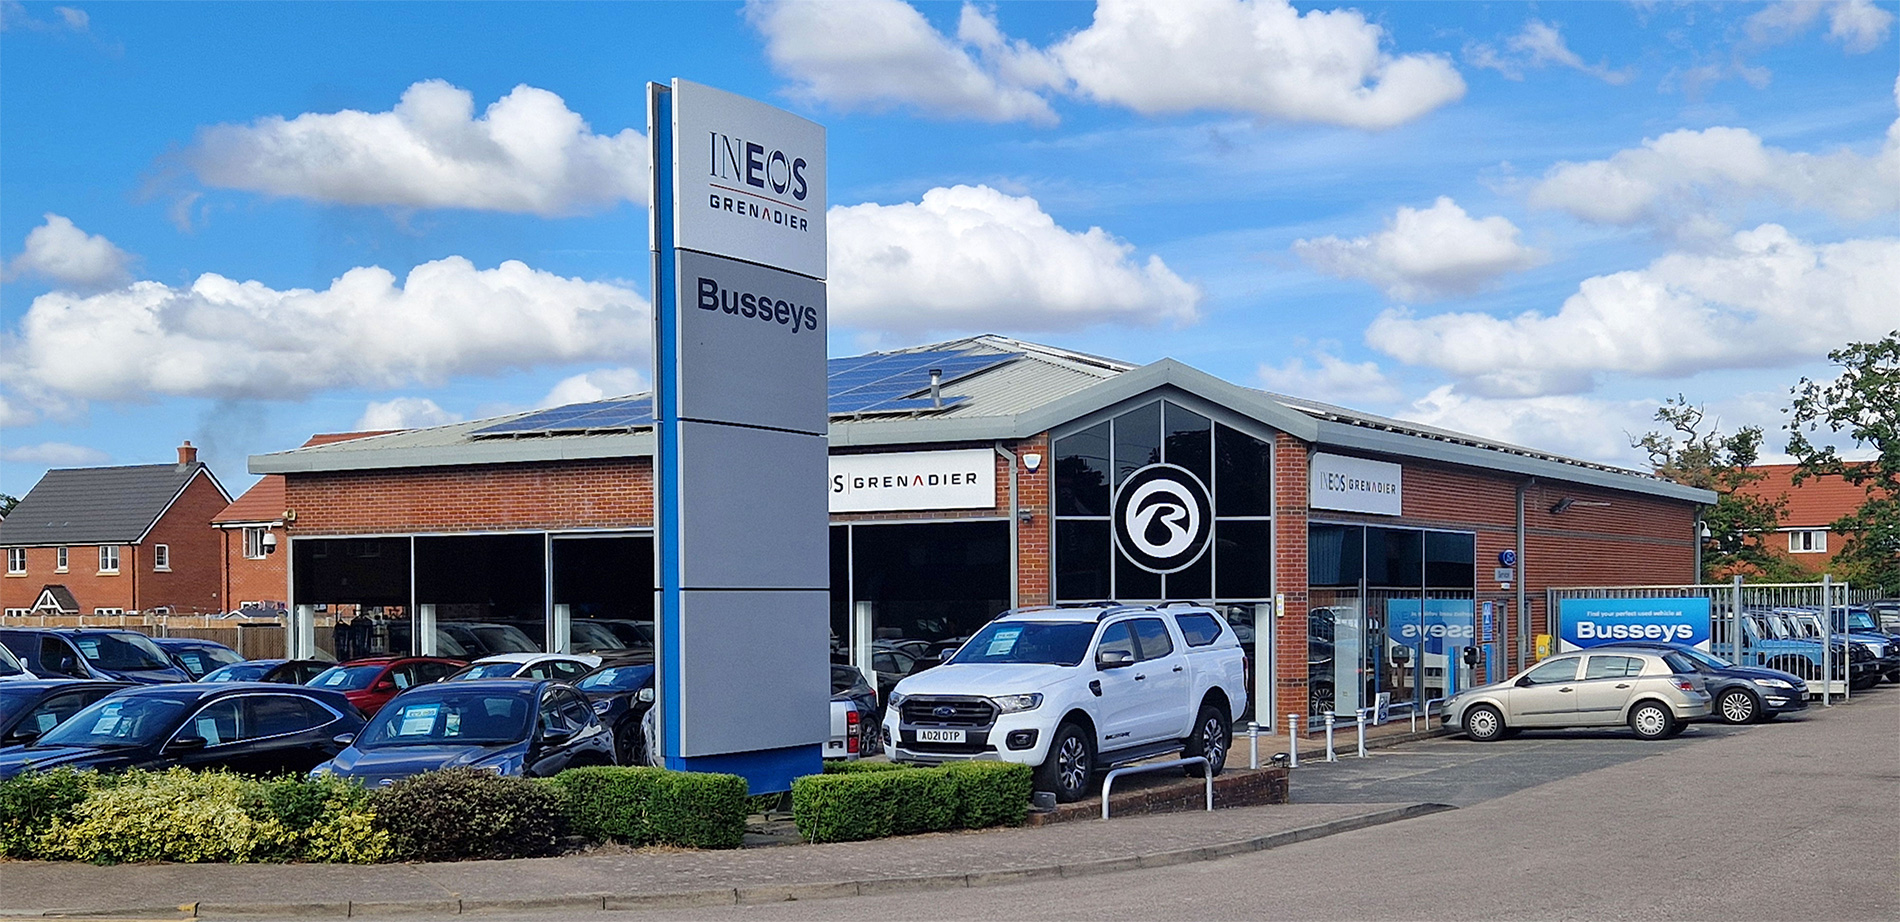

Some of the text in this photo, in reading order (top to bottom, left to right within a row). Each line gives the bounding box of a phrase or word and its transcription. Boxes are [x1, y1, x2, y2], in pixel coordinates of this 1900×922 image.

[709, 131, 808, 201] INEOS
[709, 194, 808, 232] GRENADIER
[697, 277, 818, 334] Busseys
[853, 472, 978, 489] GRENADIER
[1320, 471, 1396, 495] INEOS GRENADIER
[1576, 621, 1694, 643] Busseys
